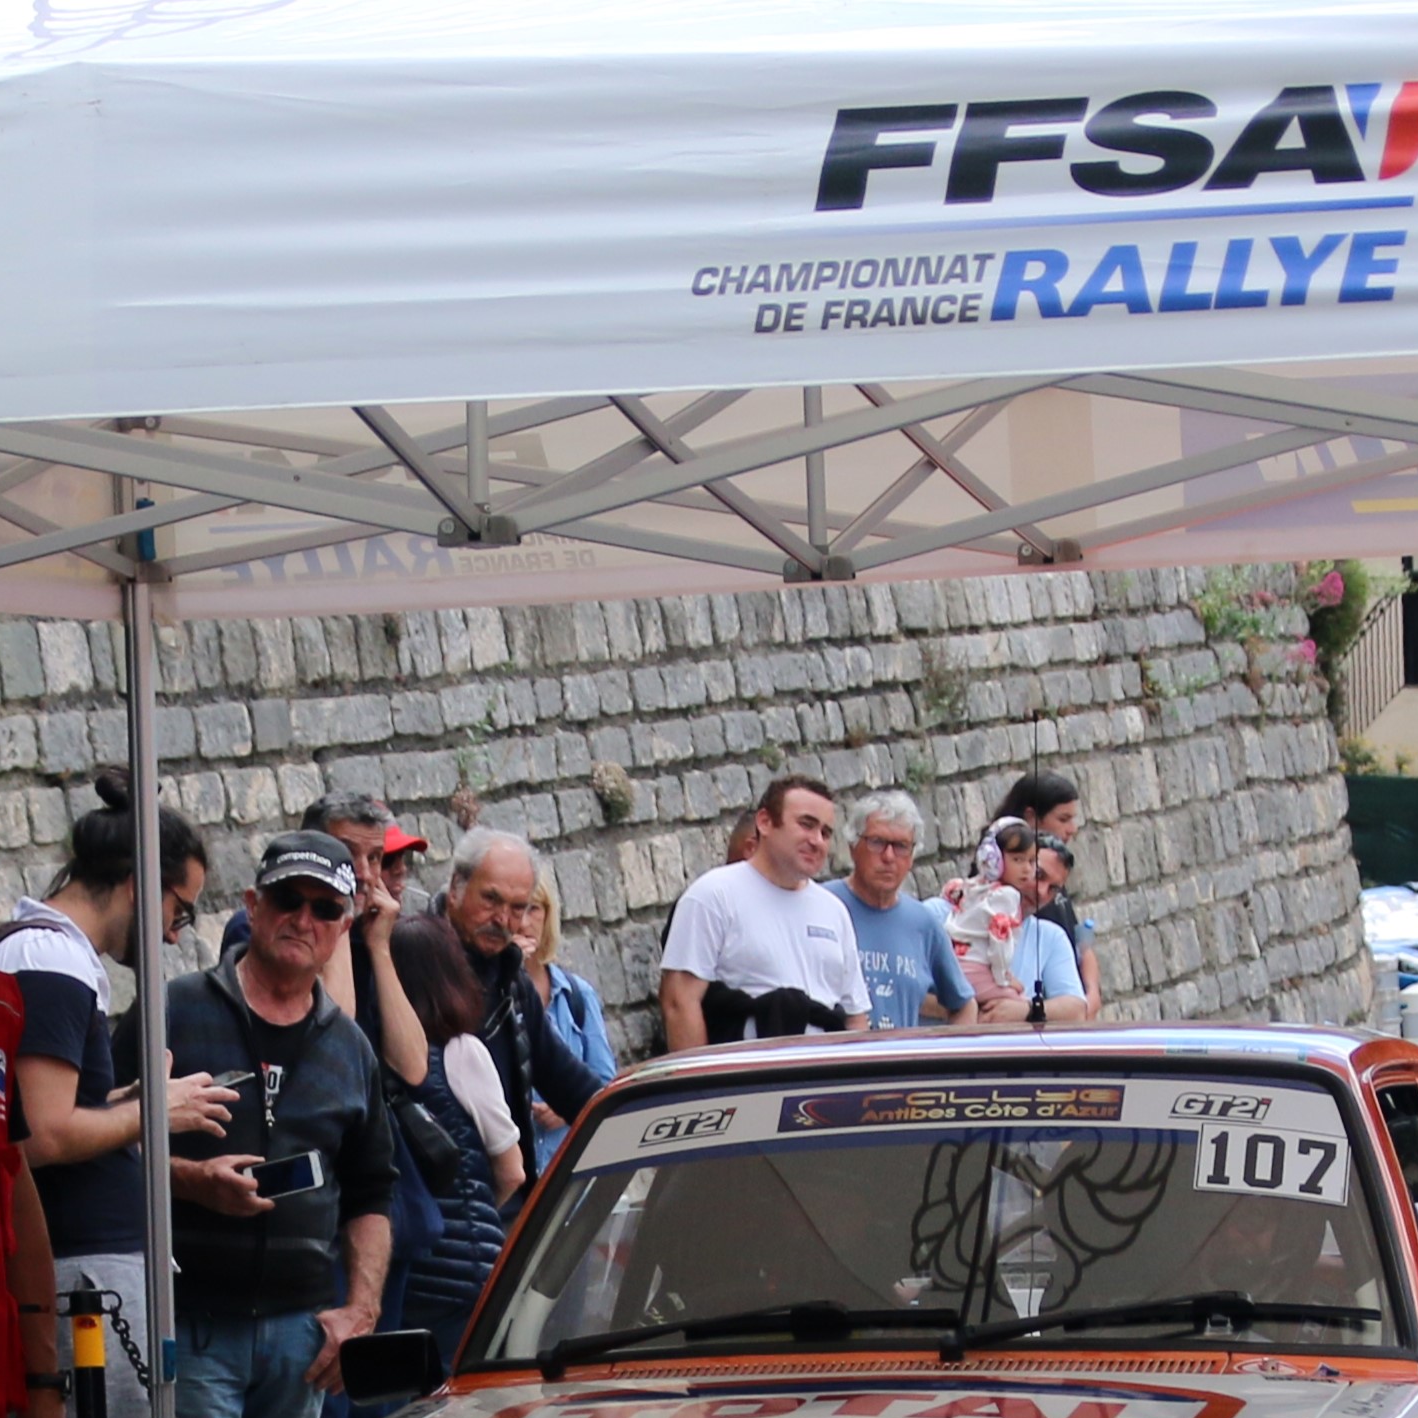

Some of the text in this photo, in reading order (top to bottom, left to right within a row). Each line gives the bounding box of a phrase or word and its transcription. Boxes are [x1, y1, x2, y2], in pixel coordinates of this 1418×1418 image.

[814, 84, 1366, 212] FFSA
[691, 252, 996, 296] CHAMPIONNAT
[990, 229, 1408, 322] RALLYE
[754, 293, 983, 333] DE FRANCE
[639, 1107, 737, 1144] GT2i
[860, 1103, 1119, 1122] Antibes Côte d'Azur
[1170, 1091, 1272, 1120] GT2i
[1206, 1130, 1337, 1195] 107
